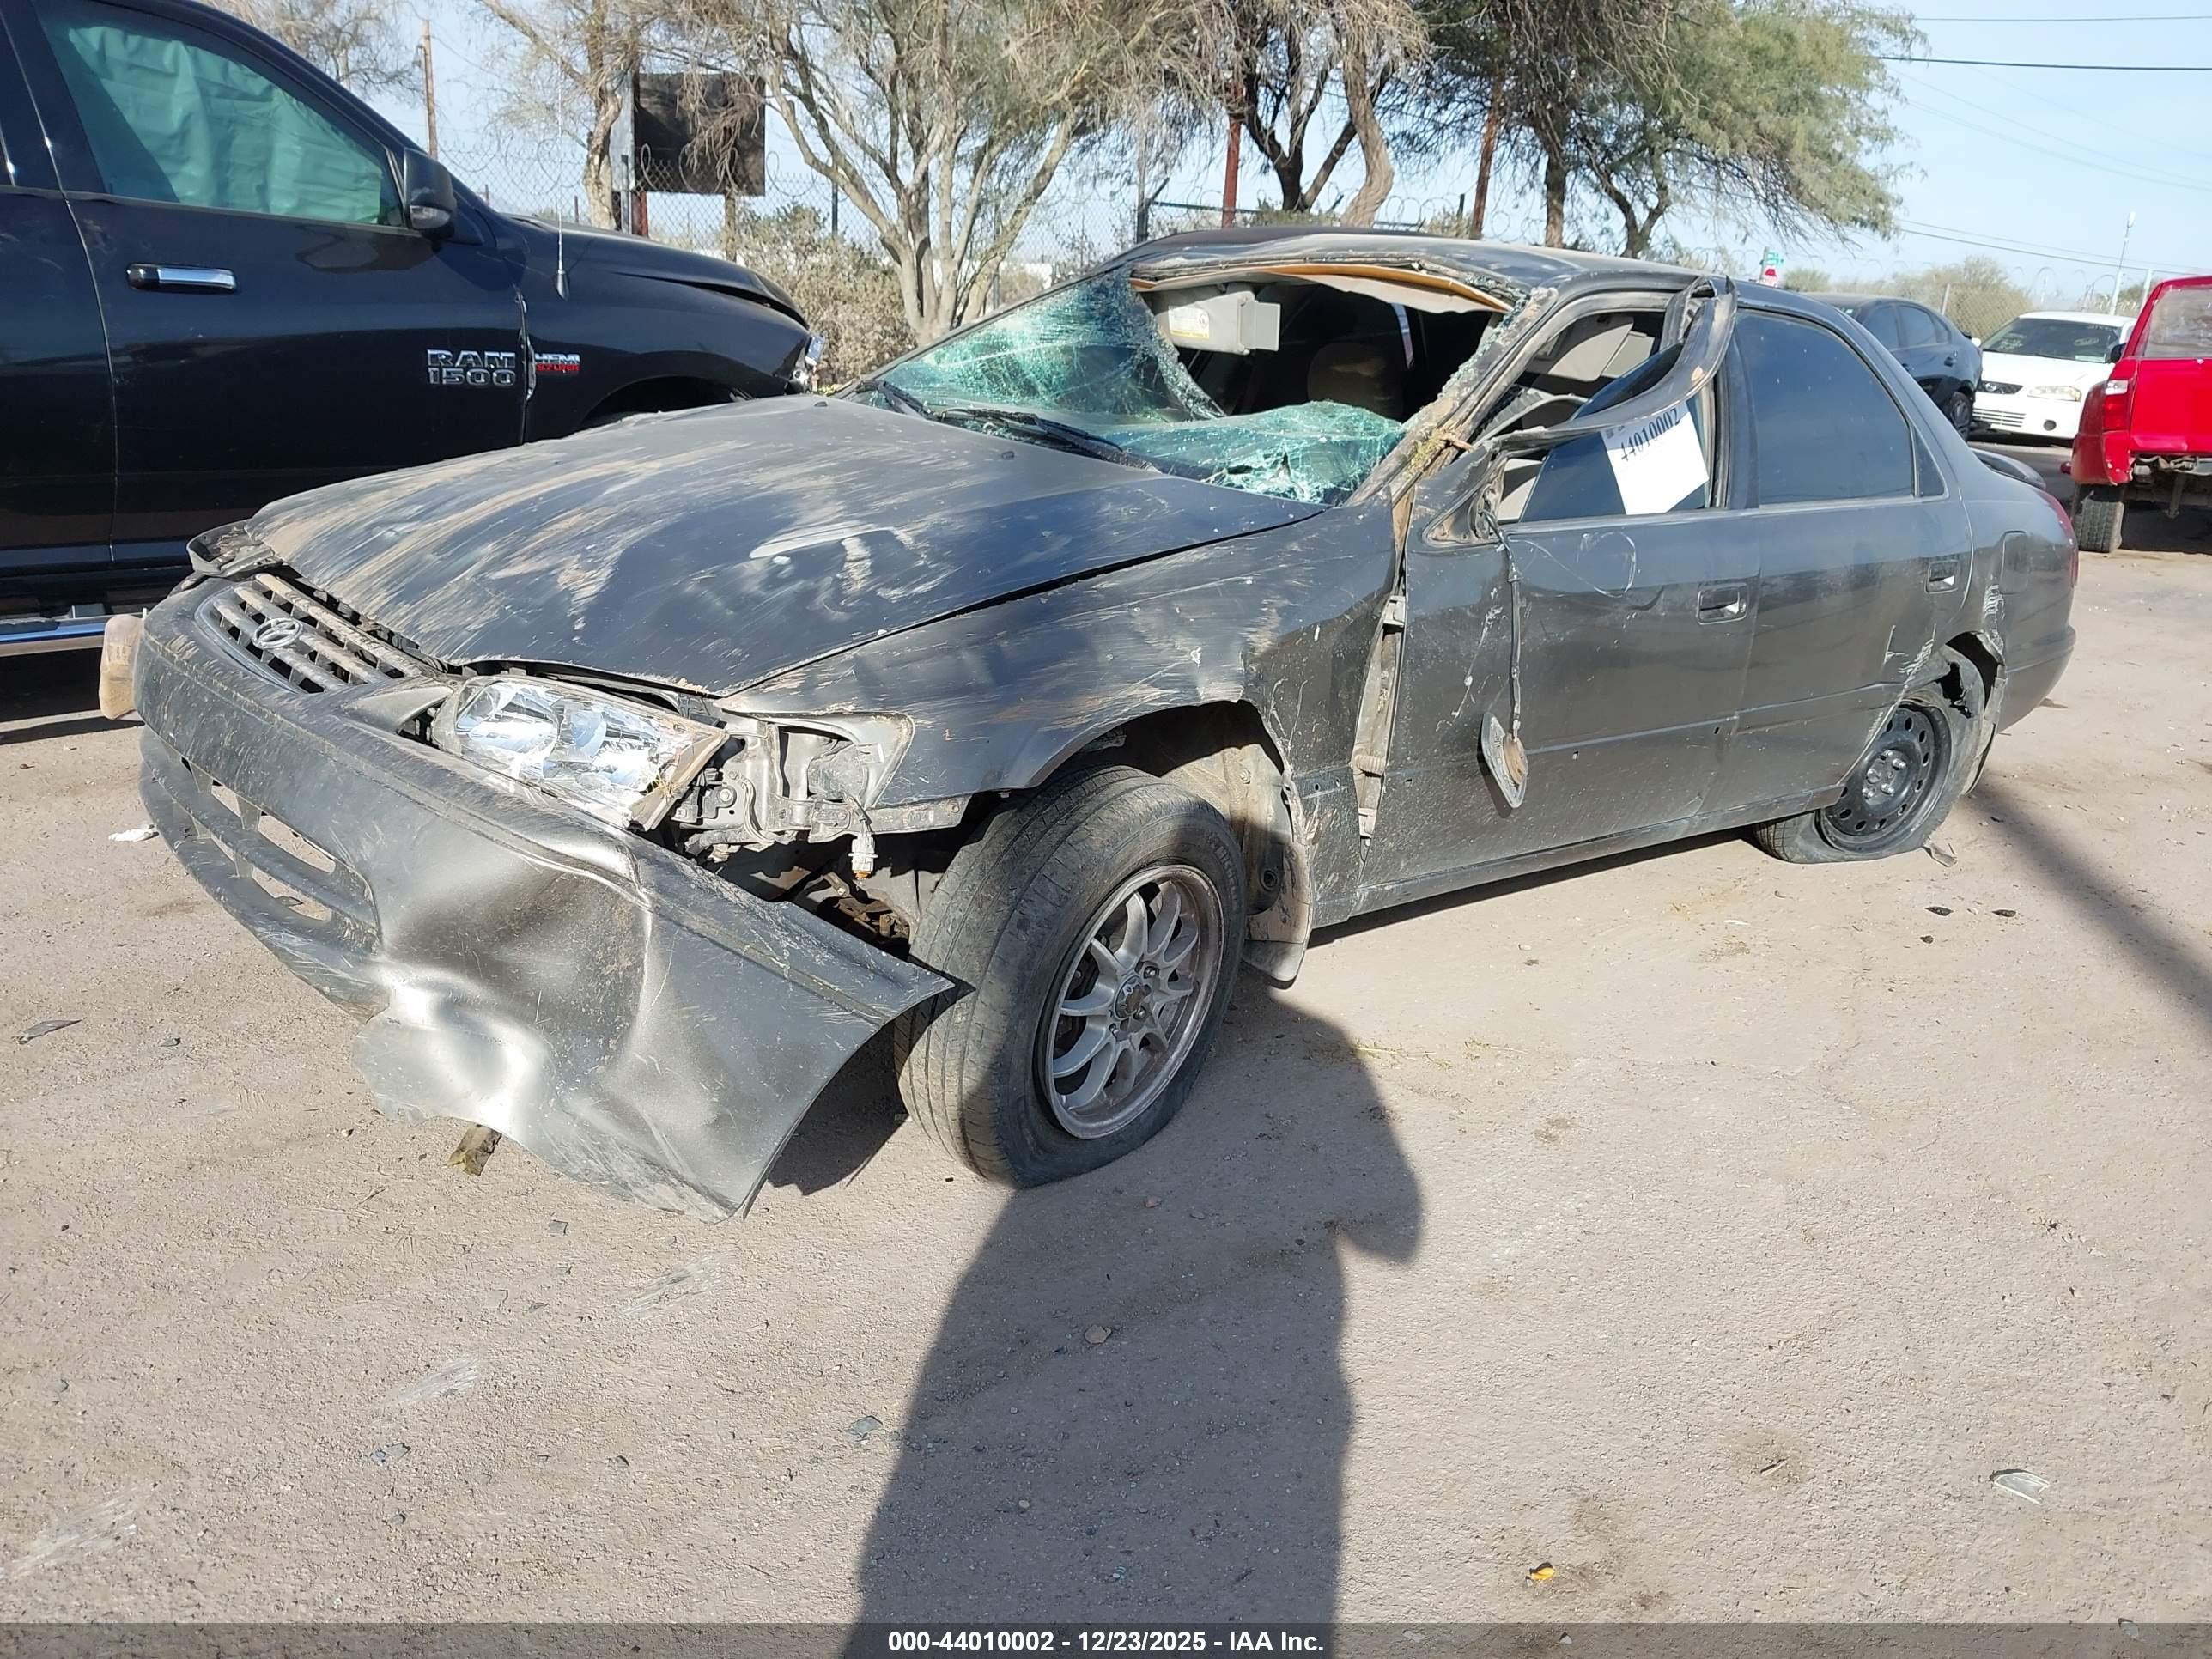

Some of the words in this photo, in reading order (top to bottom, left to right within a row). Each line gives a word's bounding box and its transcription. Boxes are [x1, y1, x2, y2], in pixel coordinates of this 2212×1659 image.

[427, 349, 516, 368] RAM
[428, 368, 516, 386] 1500
[1620, 408, 1680, 461] 44010002
